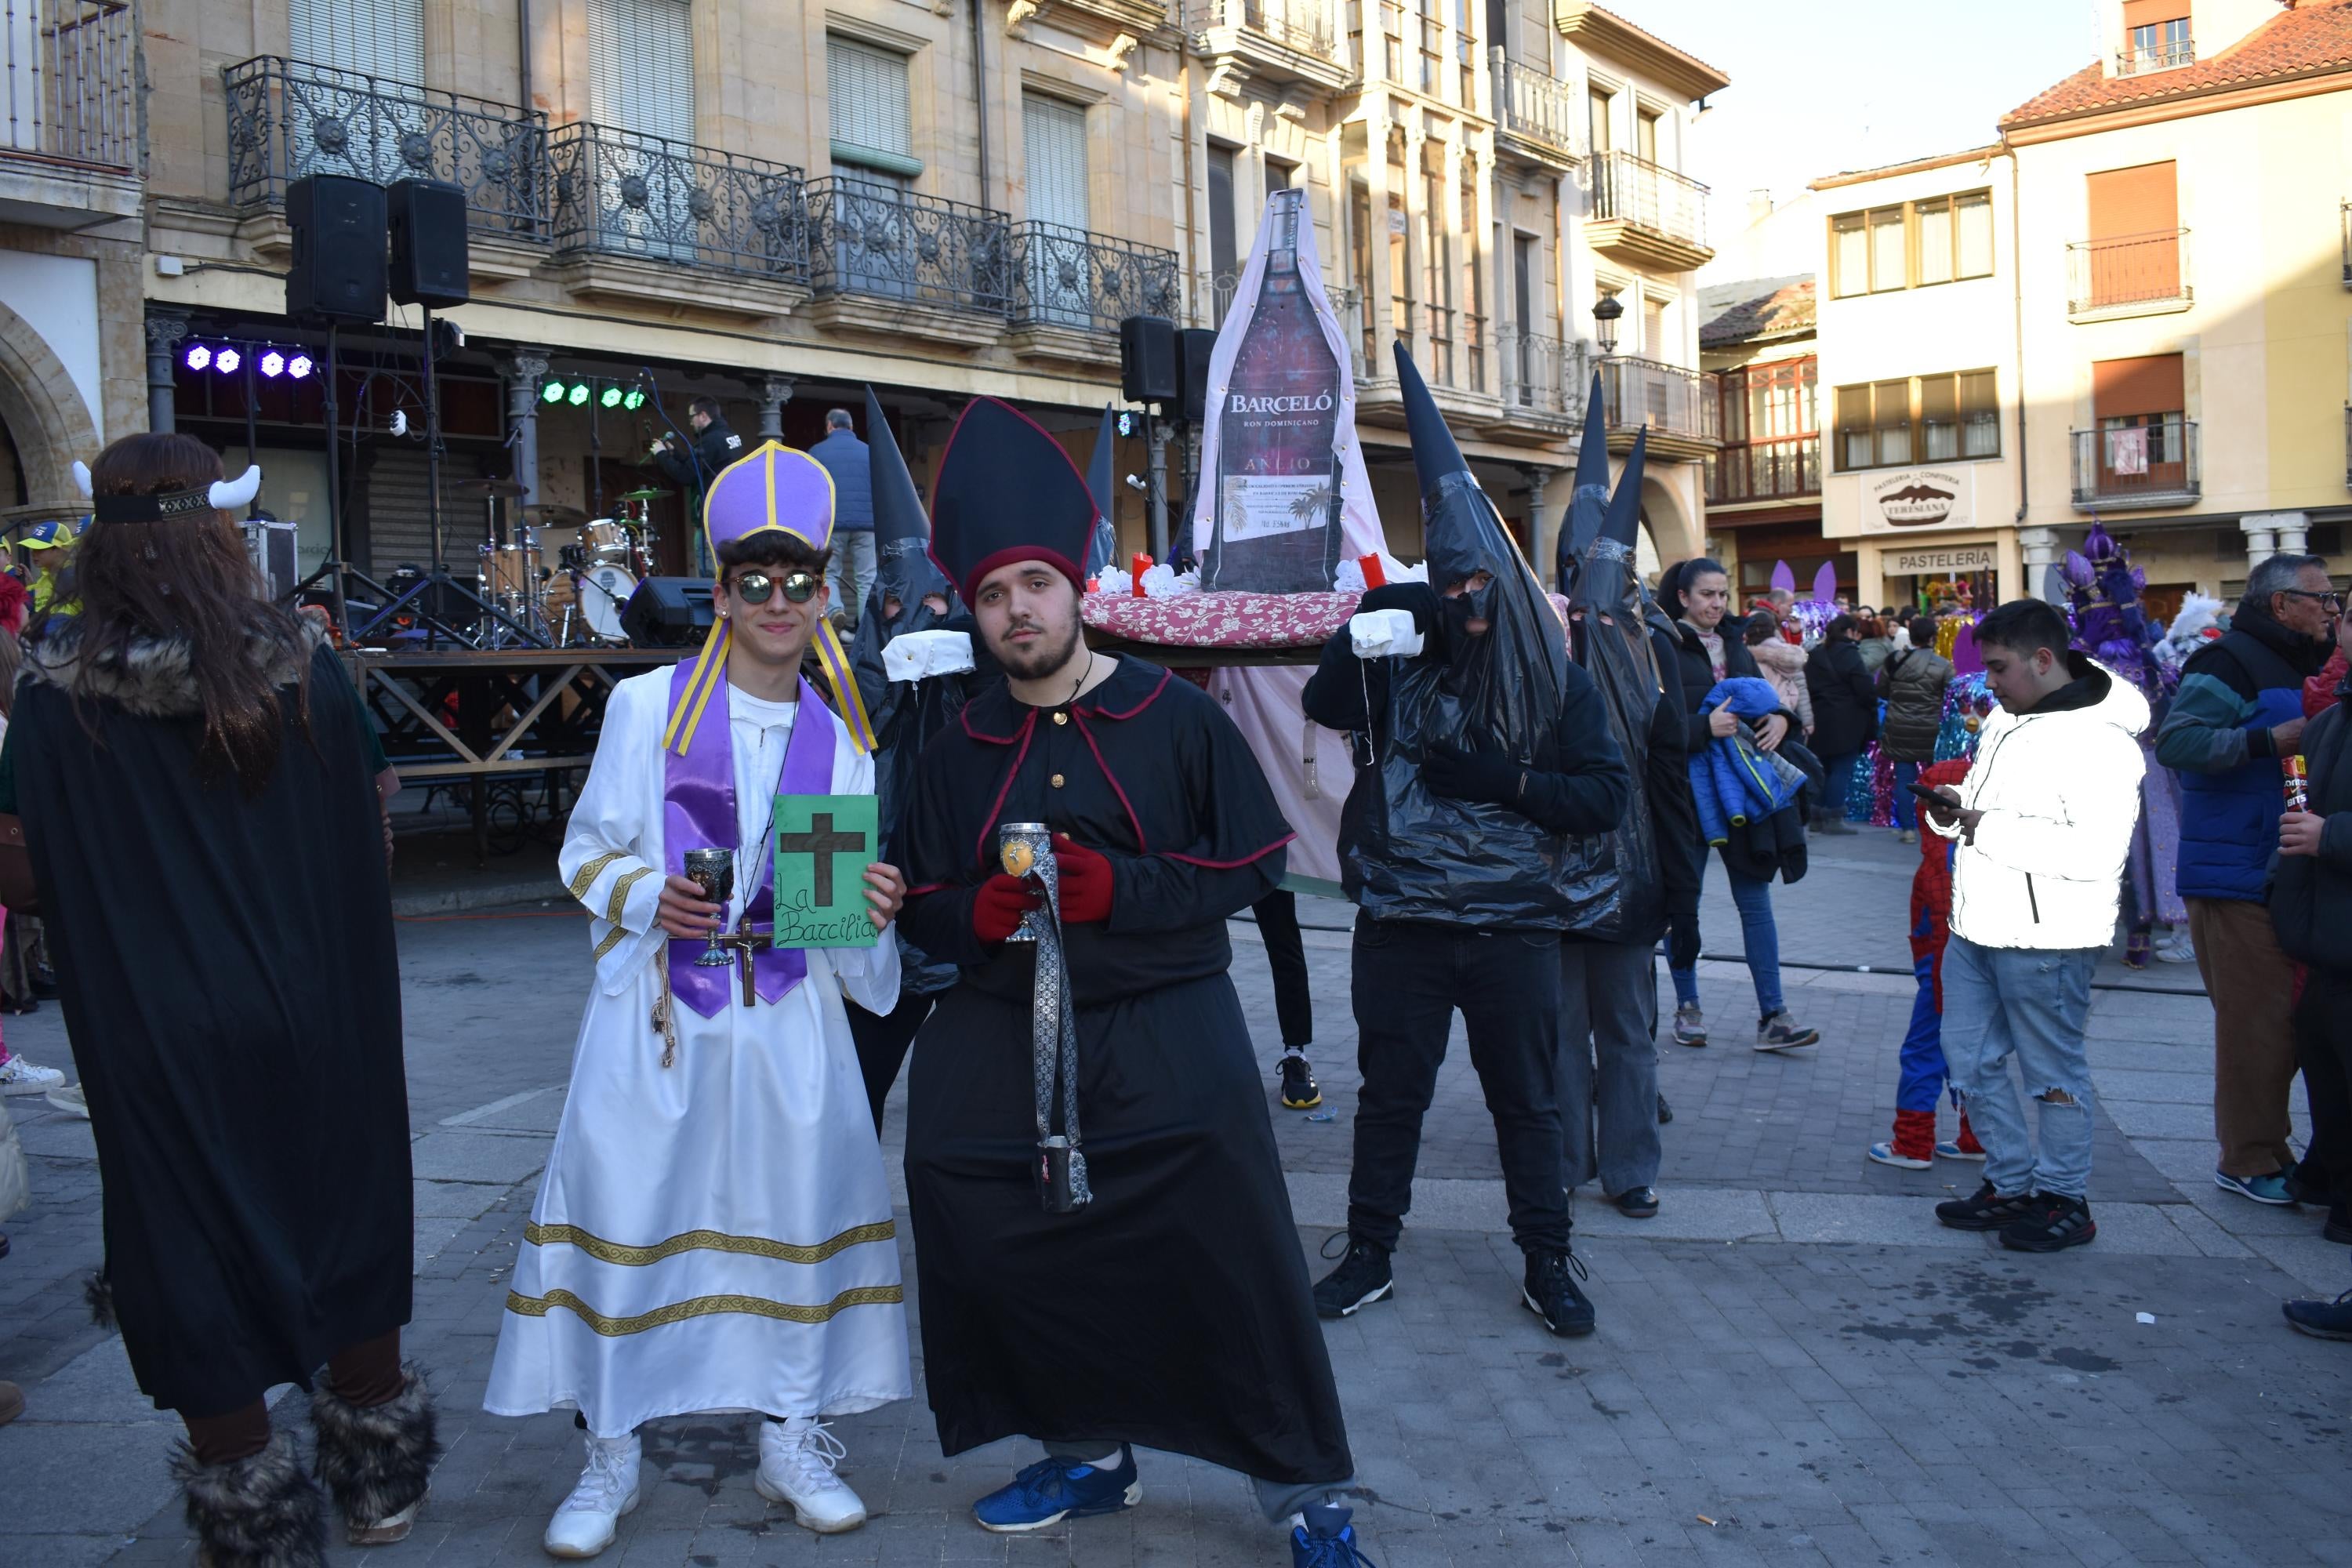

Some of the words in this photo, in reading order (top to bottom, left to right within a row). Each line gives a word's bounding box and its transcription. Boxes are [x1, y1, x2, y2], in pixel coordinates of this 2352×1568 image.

[1231, 389, 1332, 415] BARCELÓ
[1888, 503, 1945, 514] TERESIANA
[1900, 549, 1991, 569] PASTELERÍA
[2287, 793, 2307, 807] BITS
[775, 873, 816, 913] La
